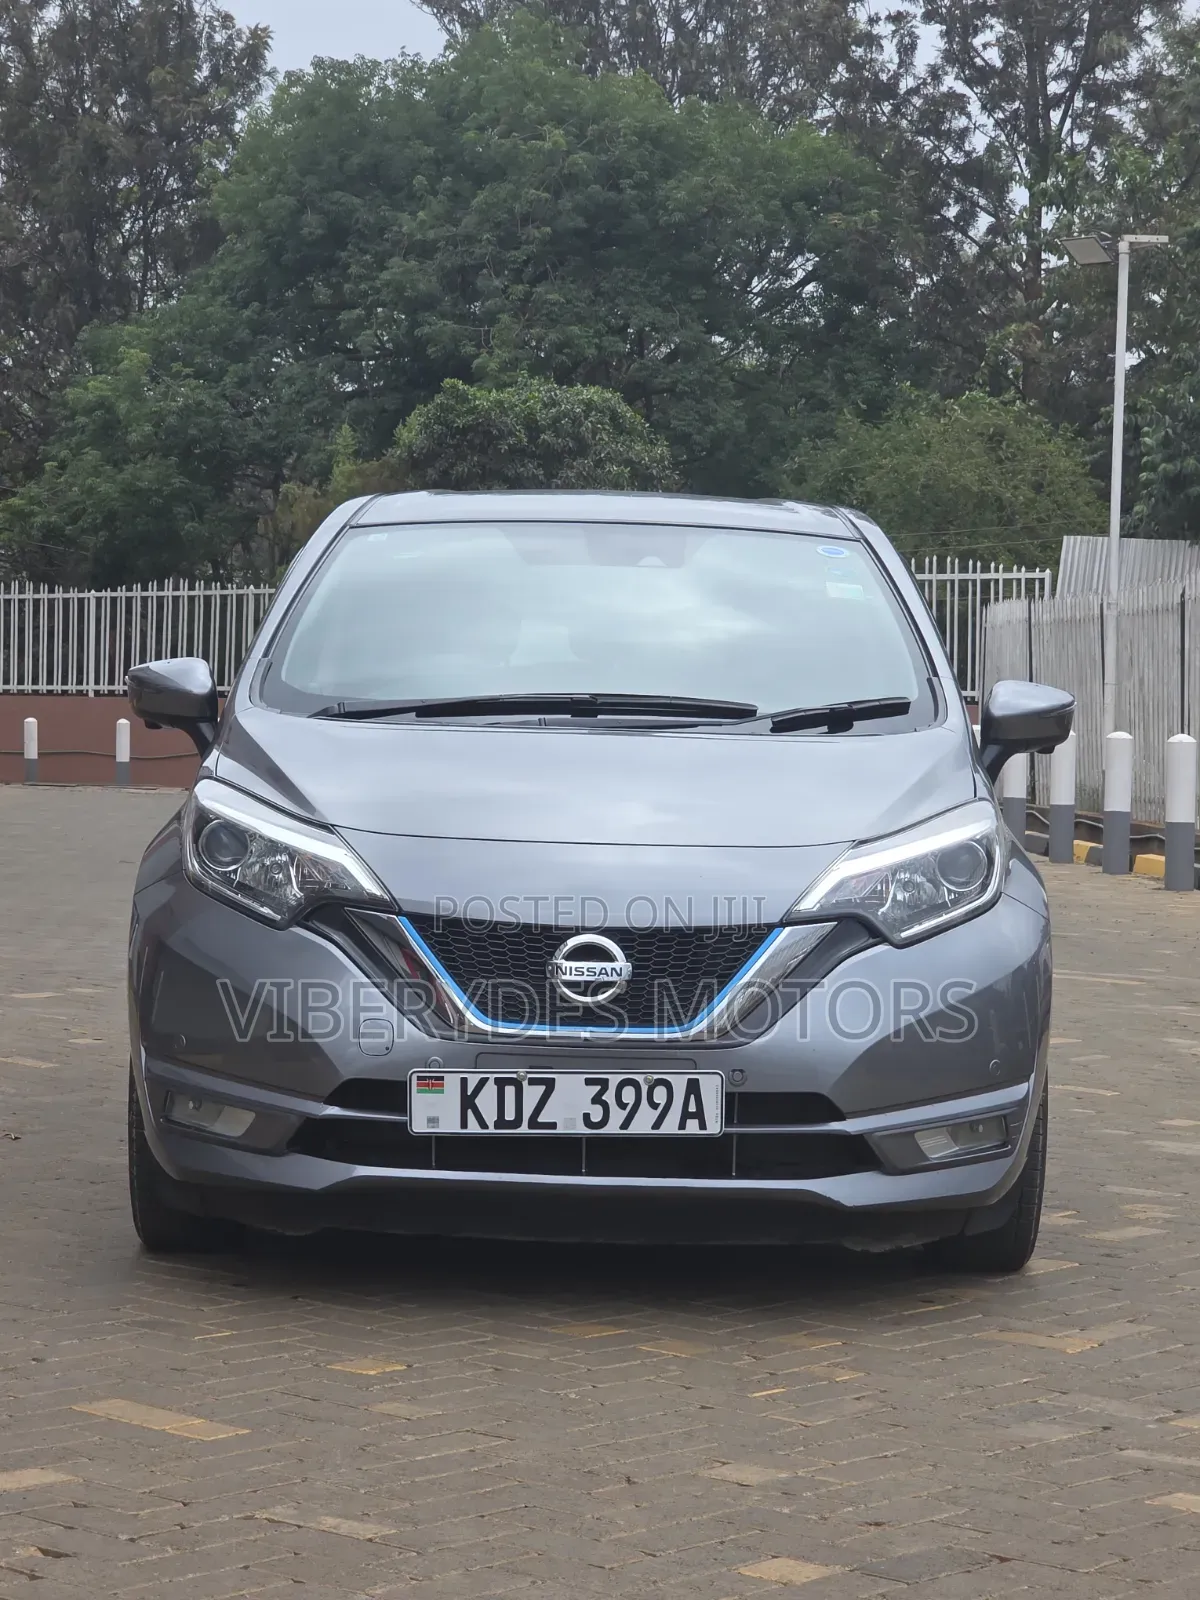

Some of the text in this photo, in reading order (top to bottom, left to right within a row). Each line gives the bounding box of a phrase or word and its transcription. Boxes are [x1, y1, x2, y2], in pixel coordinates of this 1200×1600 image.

[555, 965, 623, 978] NISSAN
[459, 1076, 558, 1131] KDZ
[582, 1076, 708, 1131] 399A
